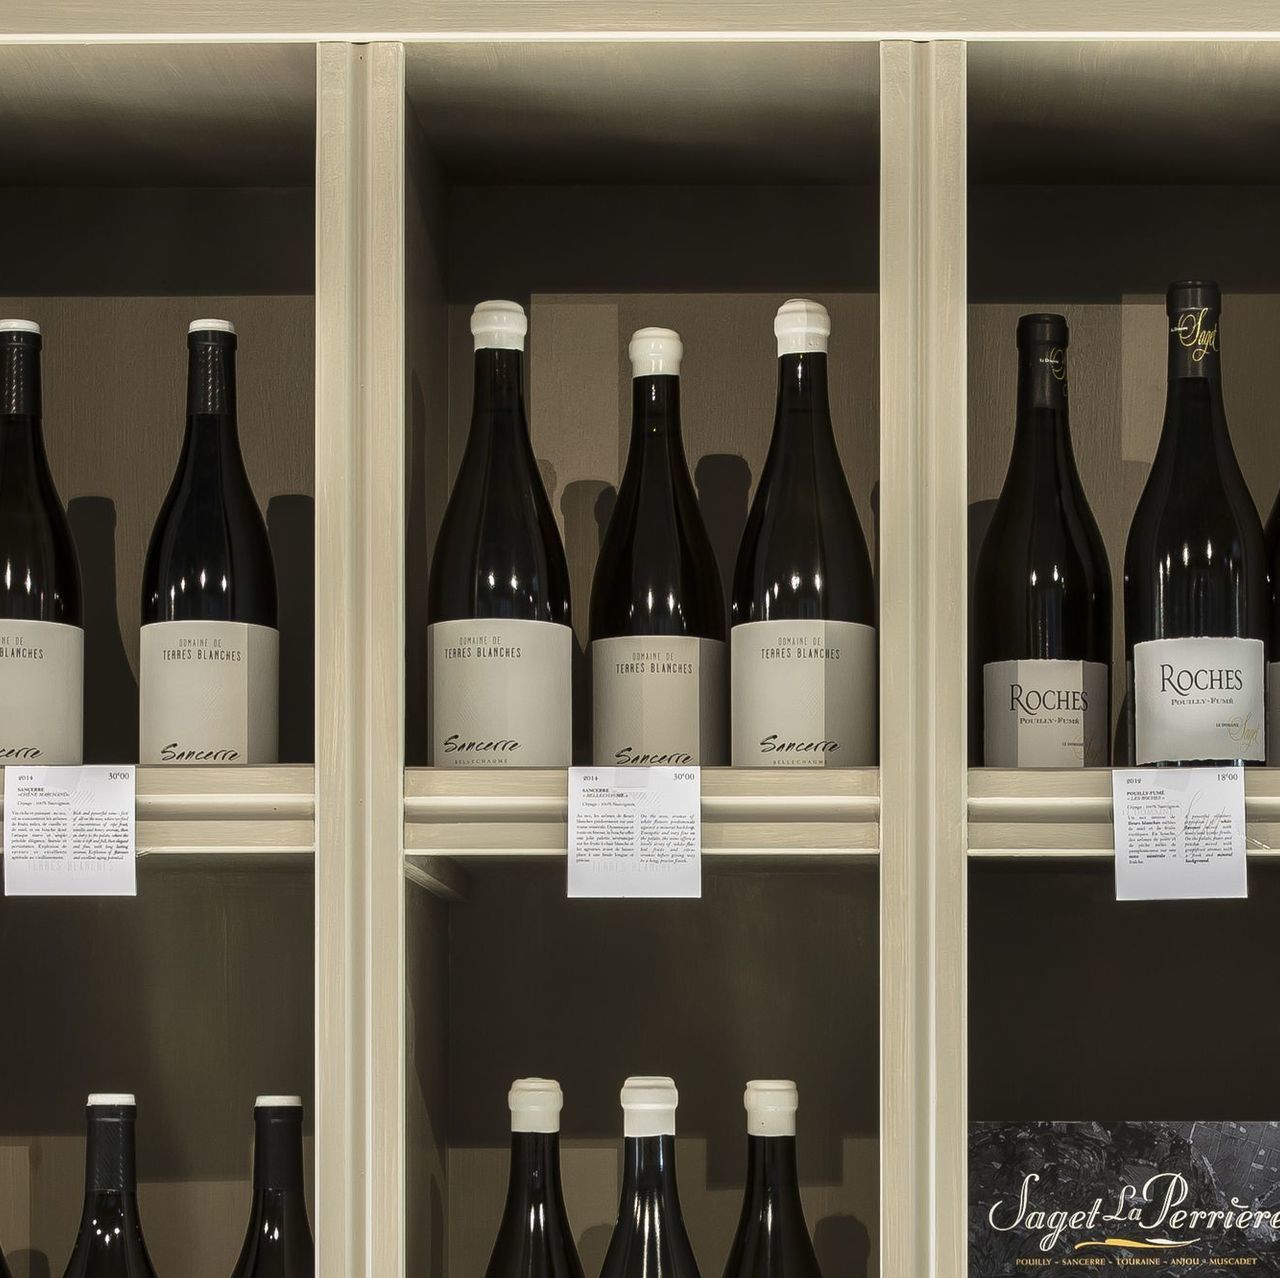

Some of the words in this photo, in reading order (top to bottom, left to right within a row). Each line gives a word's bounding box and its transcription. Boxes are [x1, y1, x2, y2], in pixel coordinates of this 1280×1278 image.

[0, 647, 45, 660] BLANCHES
[162, 649, 192, 661] TERRES
[196, 649, 242, 662] BLANCHES
[444, 647, 473, 659] TERRES
[477, 647, 522, 659] BLANCHES
[761, 647, 791, 659] TERRES
[794, 647, 841, 660] BLANCHES
[616, 662, 647, 674] TERRES
[650, 662, 693, 674] BLANCHES
[1160, 663, 1243, 697] ROCHES
[1009, 684, 1089, 716] ROCHES
[160, 742, 242, 761] Sancerre
[443, 734, 523, 753] Sancerre
[759, 734, 841, 754] Sancerre
[615, 747, 694, 765] Sancerre
[988, 1173, 1102, 1252] Saget
[1103, 1185, 1142, 1222] La
[1016, 1258, 1052, 1266] POUILLY
[1062, 1257, 1106, 1266] SANCERRE
[1116, 1257, 1161, 1266] TOURAINE
[1170, 1257, 1200, 1266] ANJOU
[1209, 1257, 1258, 1266] MUSCADET
